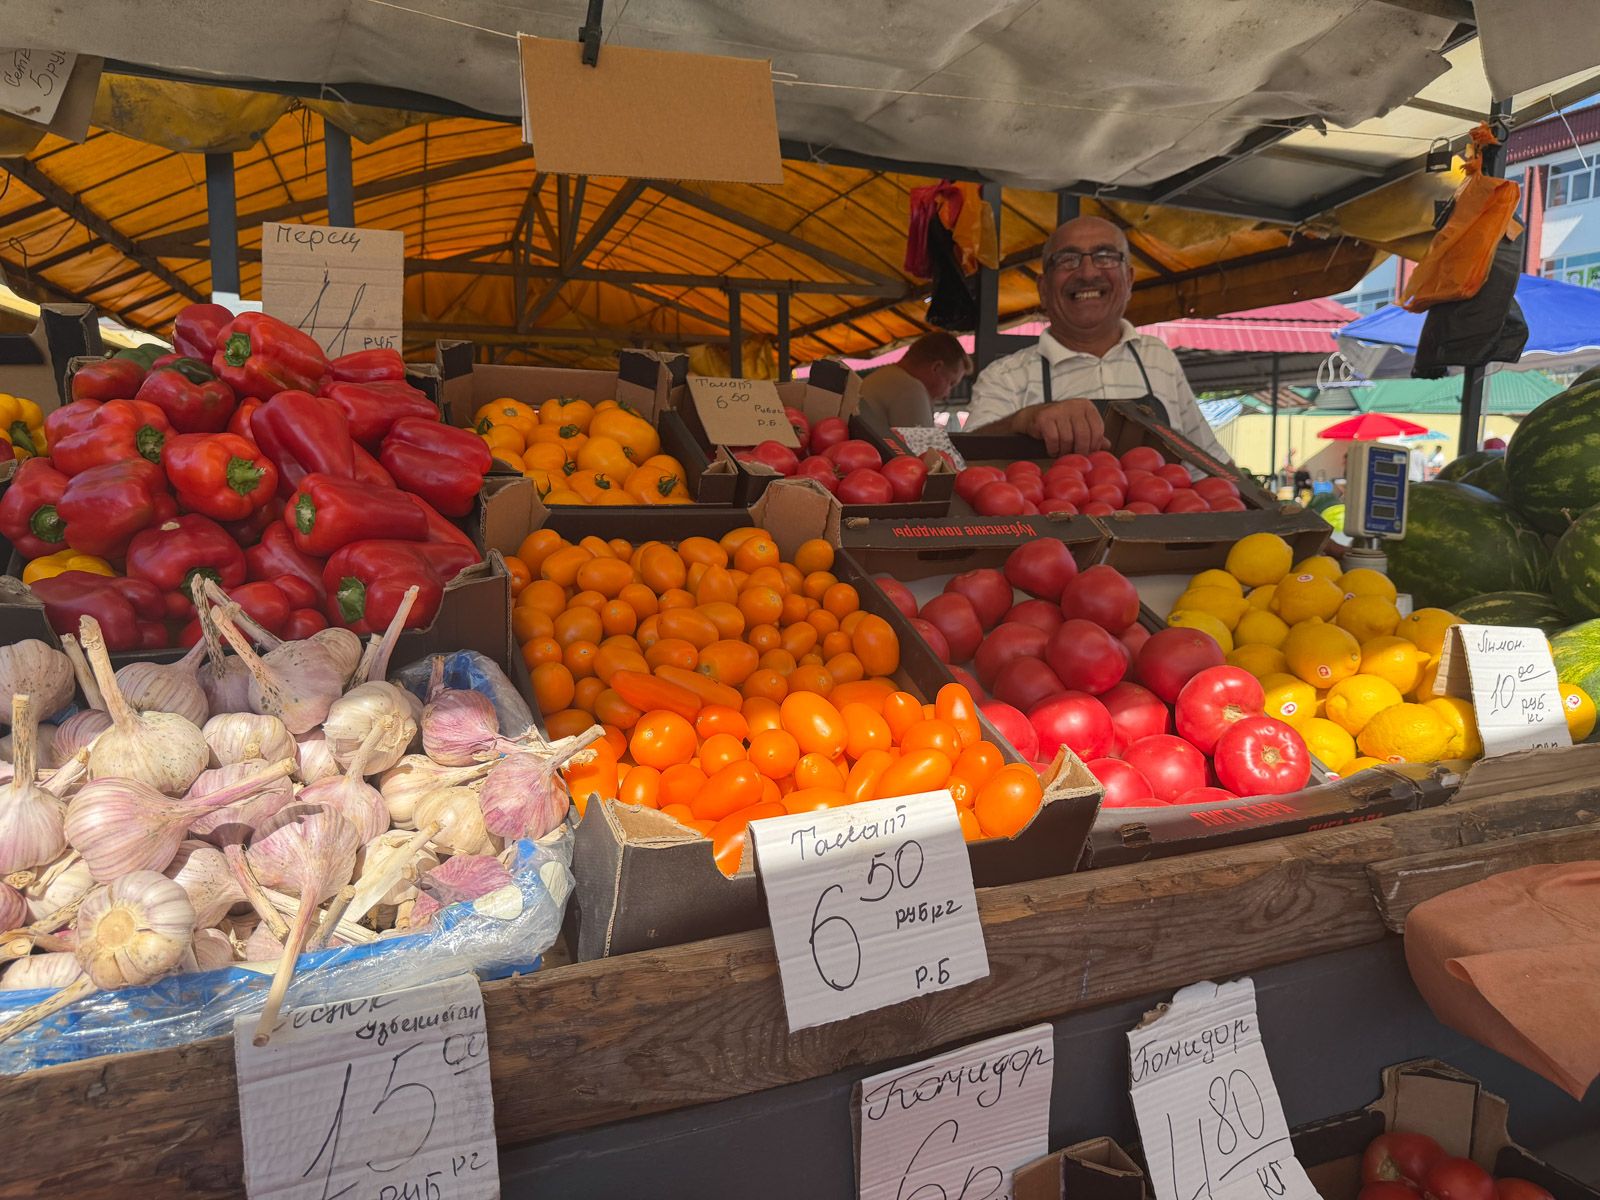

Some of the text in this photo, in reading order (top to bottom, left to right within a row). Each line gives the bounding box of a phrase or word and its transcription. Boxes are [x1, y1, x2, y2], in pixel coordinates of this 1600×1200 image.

[29, 69, 53, 96] 5
[276, 225, 361, 252] Перец
[717, 393, 750, 409] 6 50
[891, 520, 1038, 538] Кубанские помидоры
[1490, 673, 1516, 709] 10
[808, 839, 924, 991] 6 50
[1131, 1019, 1250, 1083] Помидор
[1208, 1069, 1265, 1156] 80
